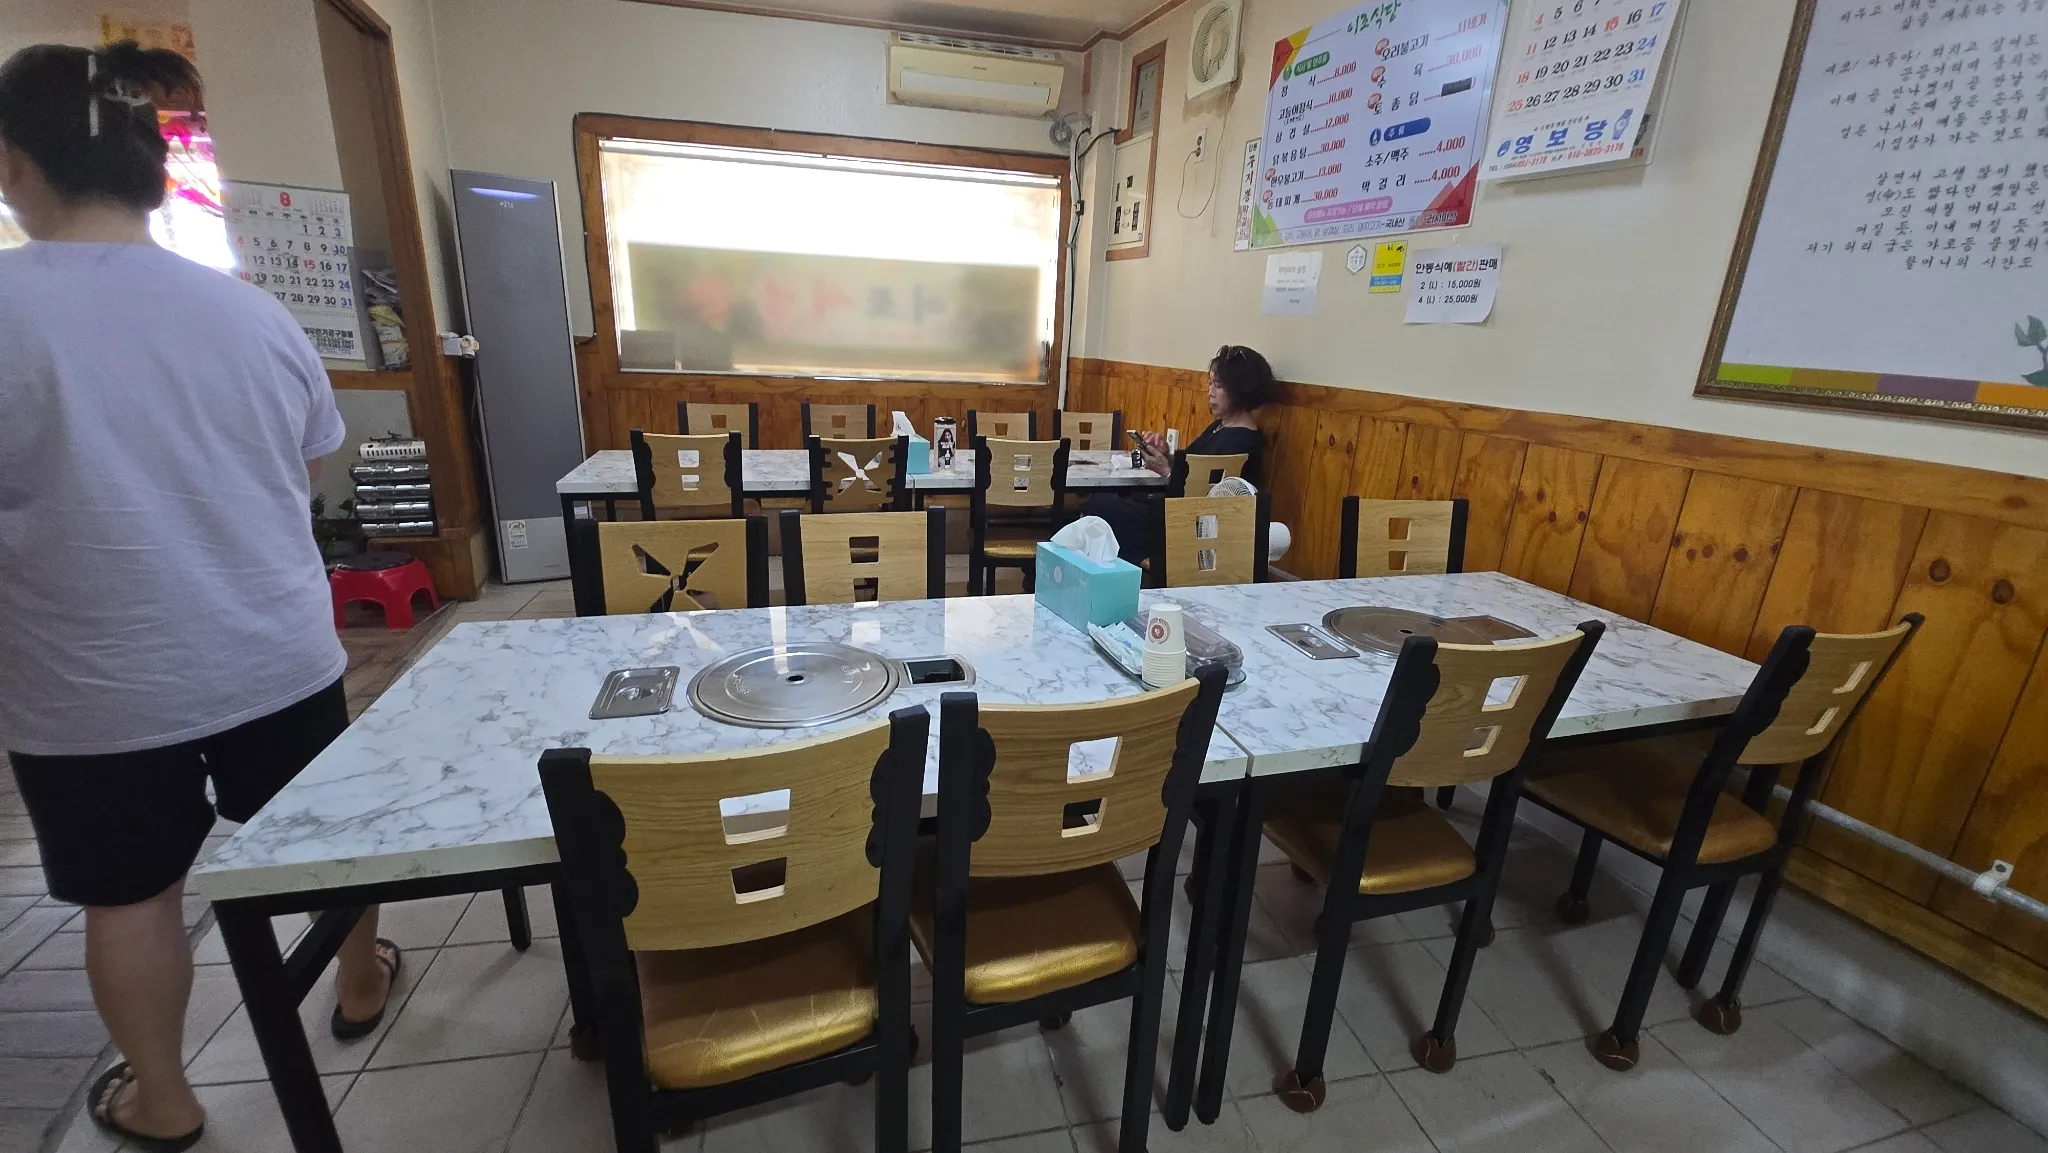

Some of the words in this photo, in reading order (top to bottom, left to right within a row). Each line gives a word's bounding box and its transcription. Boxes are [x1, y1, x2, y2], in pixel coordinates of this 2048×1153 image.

[1347, 0, 1401, 35] 이조식당
[1535, 13, 1544, 25] 4
[1554, 6, 1563, 19] 5
[1574, 0, 1583, 12] 6
[1526, 43, 1538, 55] 11
[1544, 36, 1557, 50] 12
[1562, 30, 1577, 44] 13
[1582, 23, 1597, 38] 14
[1604, 16, 1620, 32] 15
[1626, 9, 1642, 25] 16
[1650, 1, 1667, 17] 17
[1381, 33, 1429, 61] 오리불고기
[1446, 44, 1482, 66] 30,000
[1517, 71, 1530, 84] 18
[1534, 67, 1548, 80] 19
[1552, 60, 1569, 74] 20
[1572, 55, 1588, 68] 21
[1592, 48, 1612, 63] 22
[1613, 42, 1634, 57] 23
[1636, 35, 1657, 50] 24
[1334, 61, 1356, 78] 8,000
[1328, 88, 1353, 104] 10,000
[1508, 99, 1523, 112] 25
[1525, 95, 1541, 108] 26
[1543, 90, 1561, 104] 27
[1562, 85, 1580, 98] 28
[1583, 79, 1601, 94] 29
[1604, 74, 1624, 88] 30
[1627, 68, 1646, 83] 31
[1325, 113, 1350, 128] 12,000
[1320, 138, 1346, 154] 30,000
[1365, 147, 1409, 168] 소주/맥주
[1435, 136, 1466, 154] 4,000
[1318, 162, 1342, 177] 13,000
[1430, 166, 1461, 181] 4,000
[280, 192, 291, 207] 8
[1314, 188, 1338, 201] 30,000
[1420, 282, 1426, 290] 2
[1447, 279, 1482, 289] 15,000원
[1444, 294, 1478, 304] 25,000원
